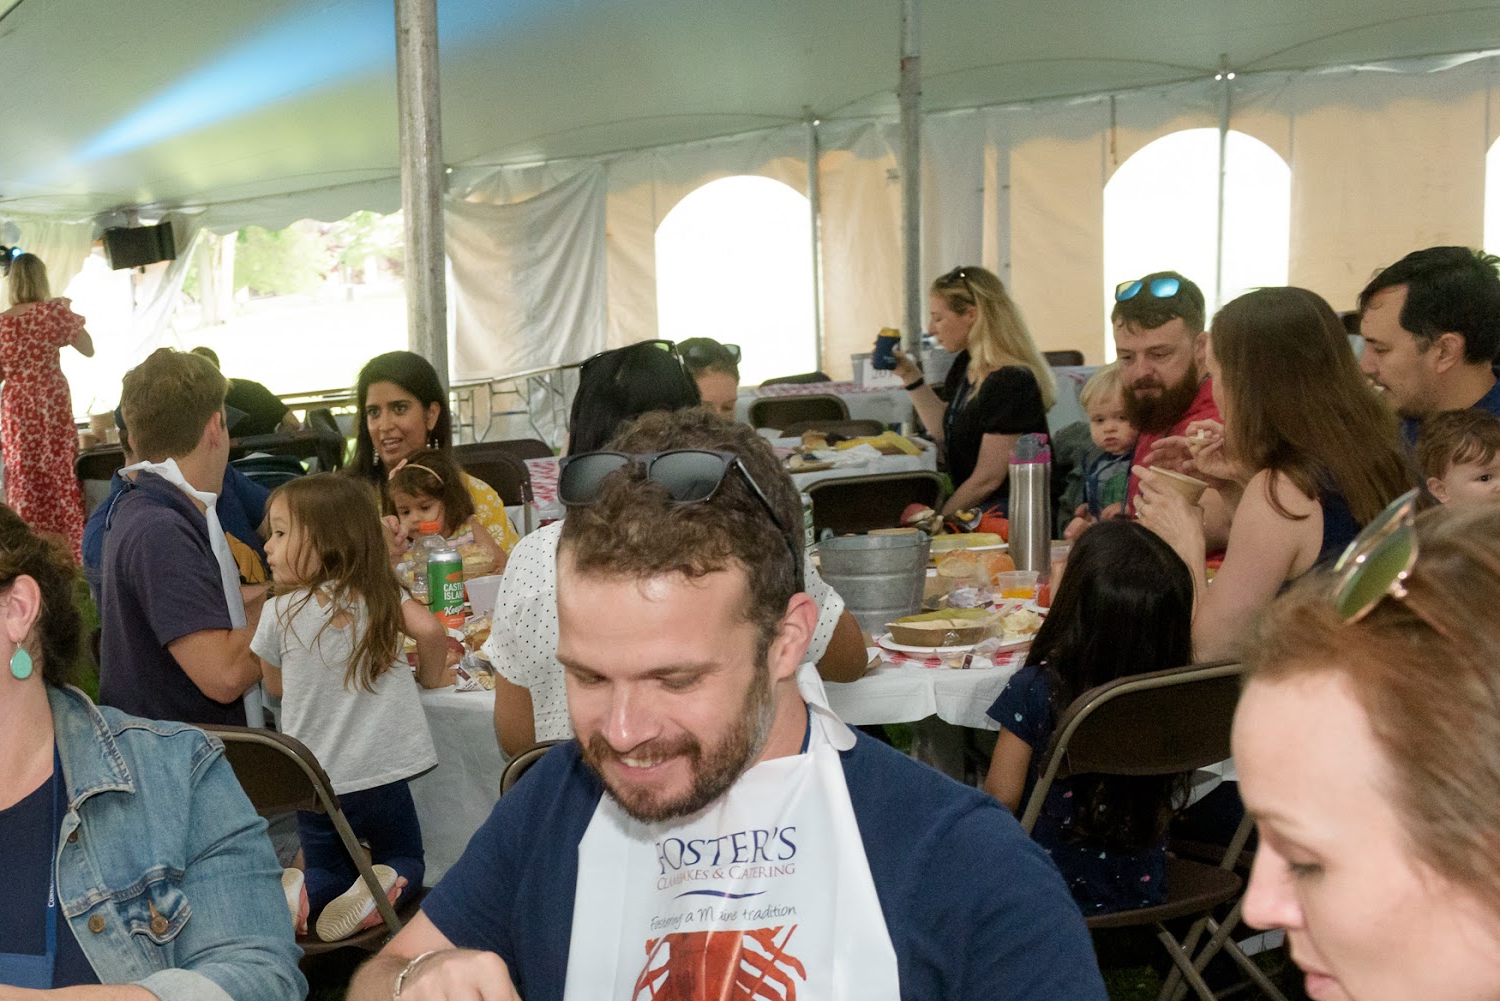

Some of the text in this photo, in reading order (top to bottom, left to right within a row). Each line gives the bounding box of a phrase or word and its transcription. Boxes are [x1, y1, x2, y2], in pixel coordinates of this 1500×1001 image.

[655, 826, 797, 875] FOSTER'S
[728, 863, 796, 880] CATERING
[742, 904, 797, 921] tradition
